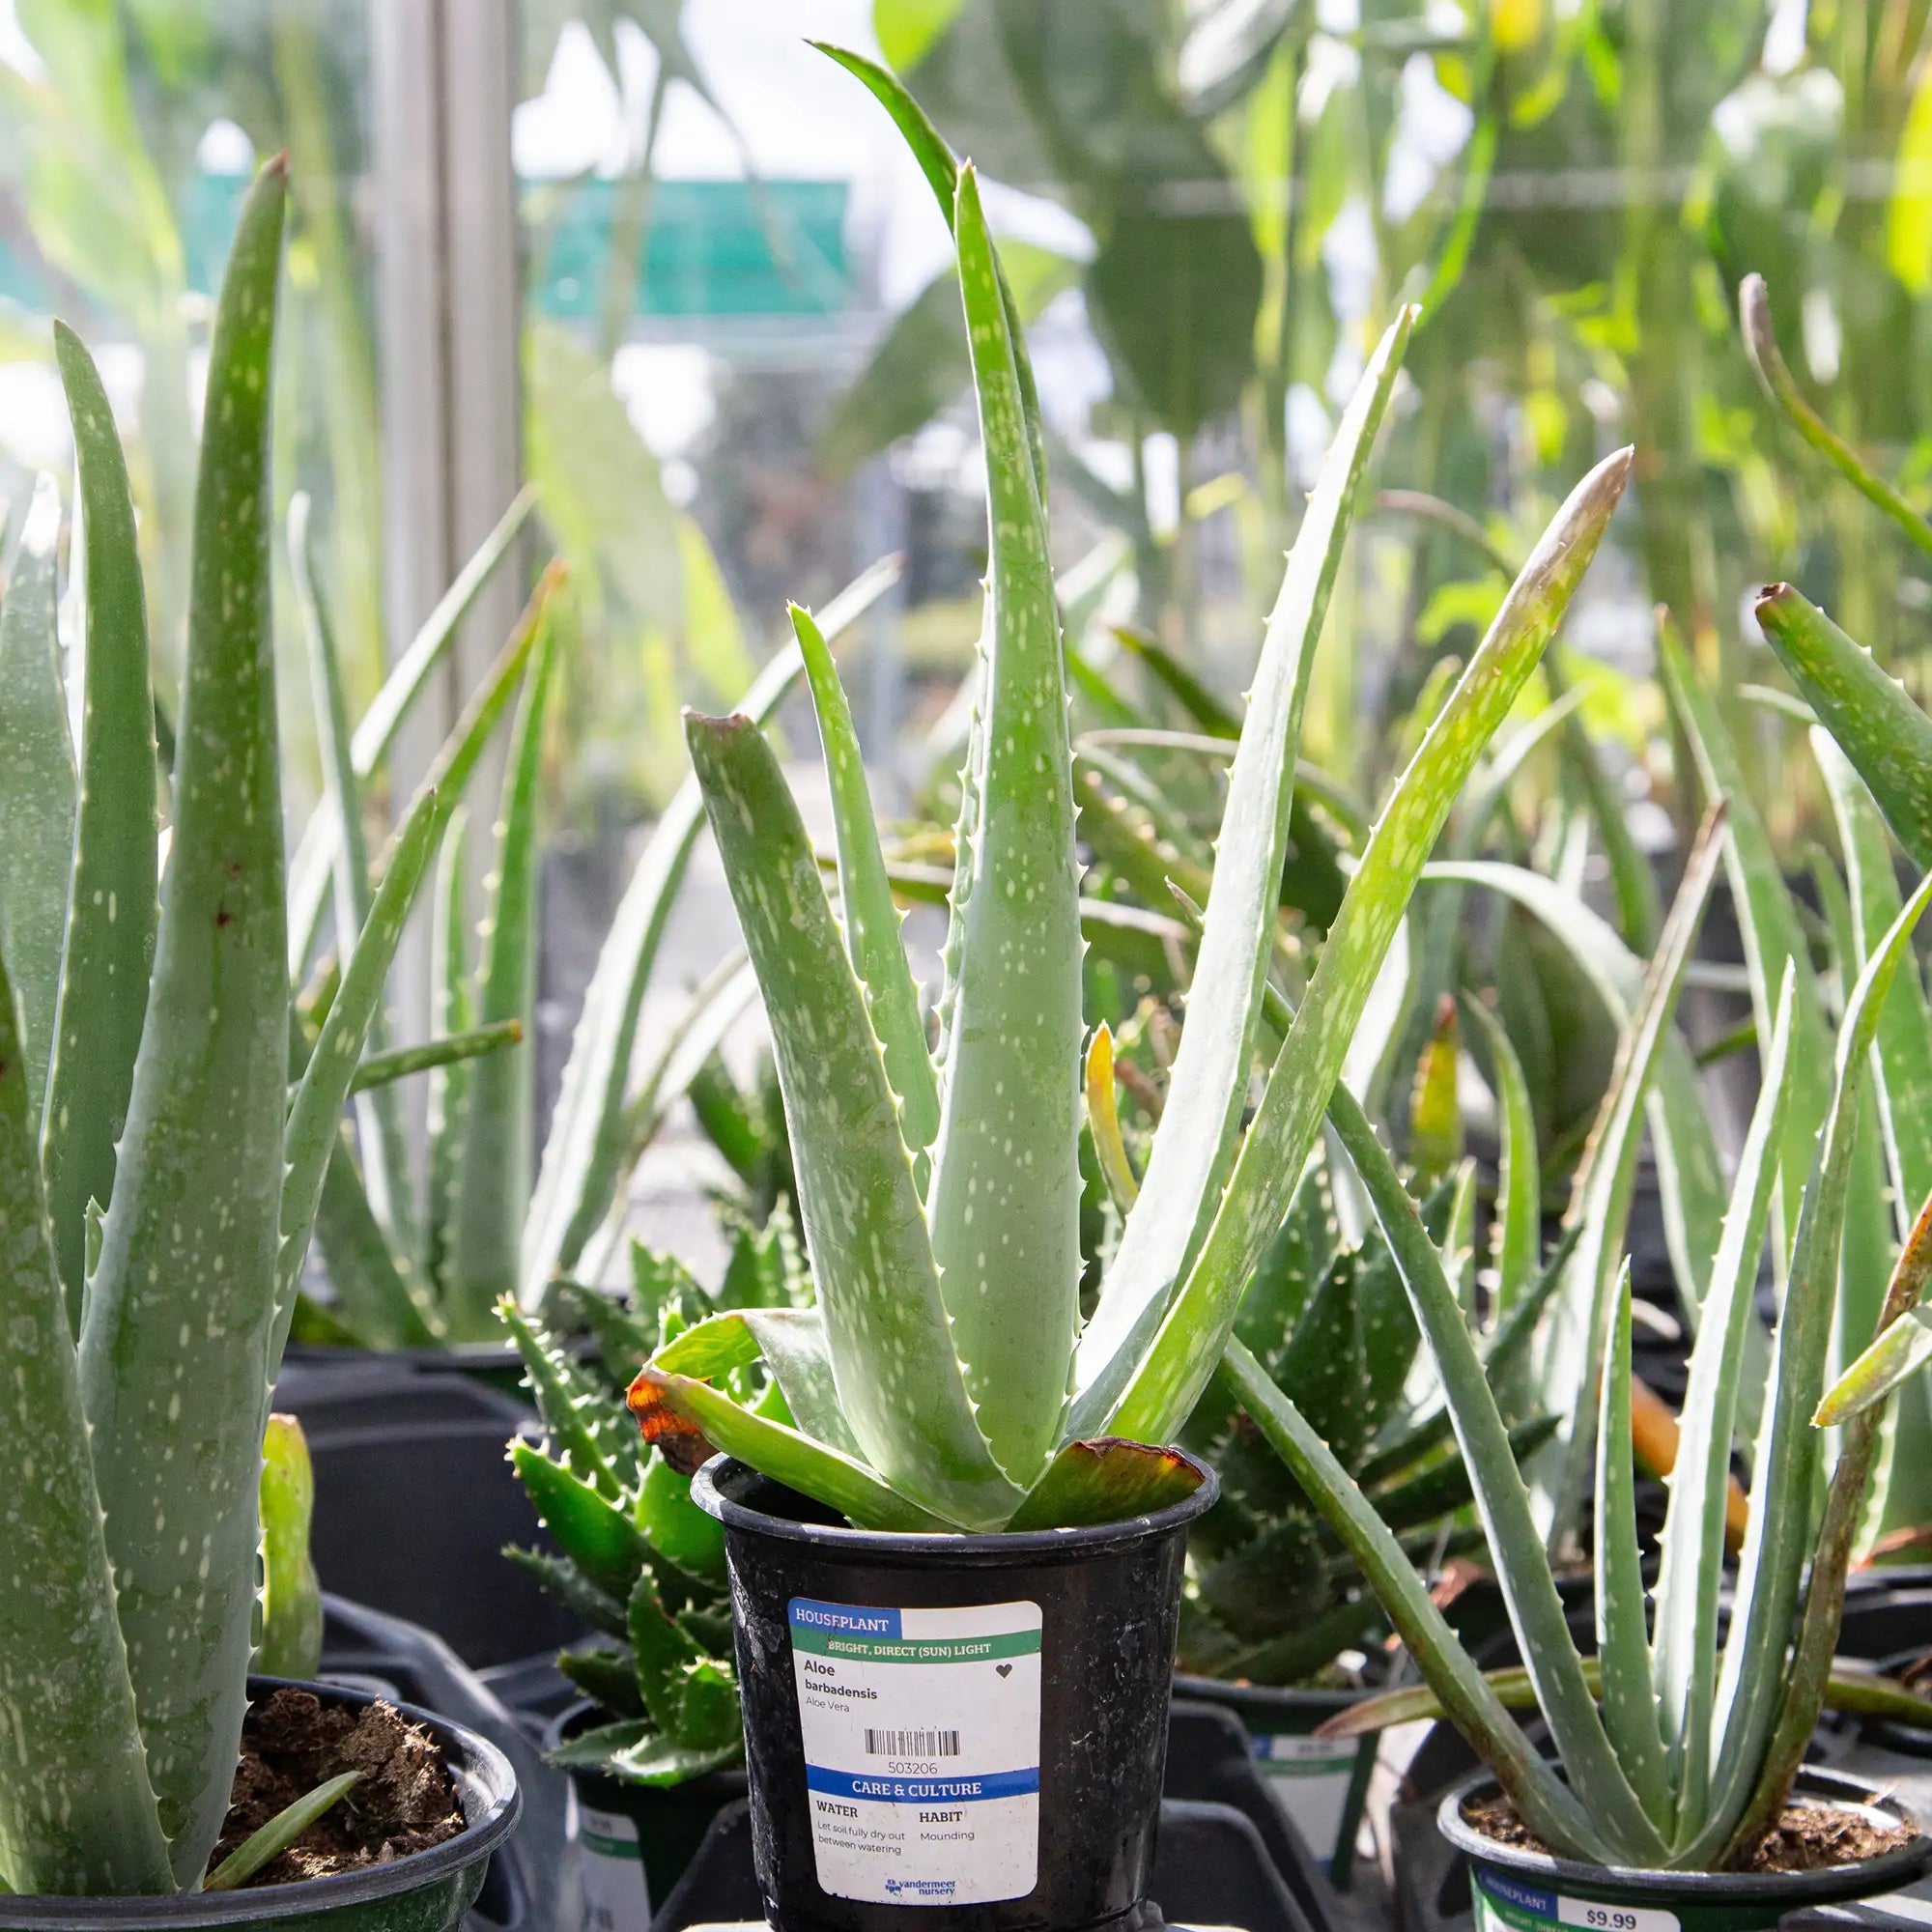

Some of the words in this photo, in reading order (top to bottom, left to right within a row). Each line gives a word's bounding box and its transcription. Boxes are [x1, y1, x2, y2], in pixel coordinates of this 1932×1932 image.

[795, 1607, 889, 1632] HOUSEPLANT
[874, 1645, 917, 1657] DIRECT
[919, 1646, 952, 1659] (SUN)
[954, 1643, 992, 1656] LIGHT
[804, 1659, 836, 1677] Aloe
[805, 1678, 878, 1700] barbadensis
[806, 1696, 826, 1709] Aloe
[828, 1700, 850, 1713] Vera
[888, 1762, 938, 1775] 503206
[852, 1780, 891, 1796] CARE
[895, 1784, 905, 1797] &
[908, 1782, 982, 1798] CULTURE
[816, 1800, 859, 1818] WATER
[919, 1811, 963, 1823] HABIT
[817, 1821, 832, 1831] Let
[833, 1825, 847, 1833] soil
[848, 1828, 868, 1839] fully
[869, 1830, 886, 1841] dry
[888, 1833, 906, 1841] out
[921, 1831, 975, 1841] Mounding
[818, 1833, 857, 1850] between
[858, 1842, 902, 1856] watering
[898, 1880, 955, 1889] vandermeer
[1587, 1909, 1637, 1930] $9.99
